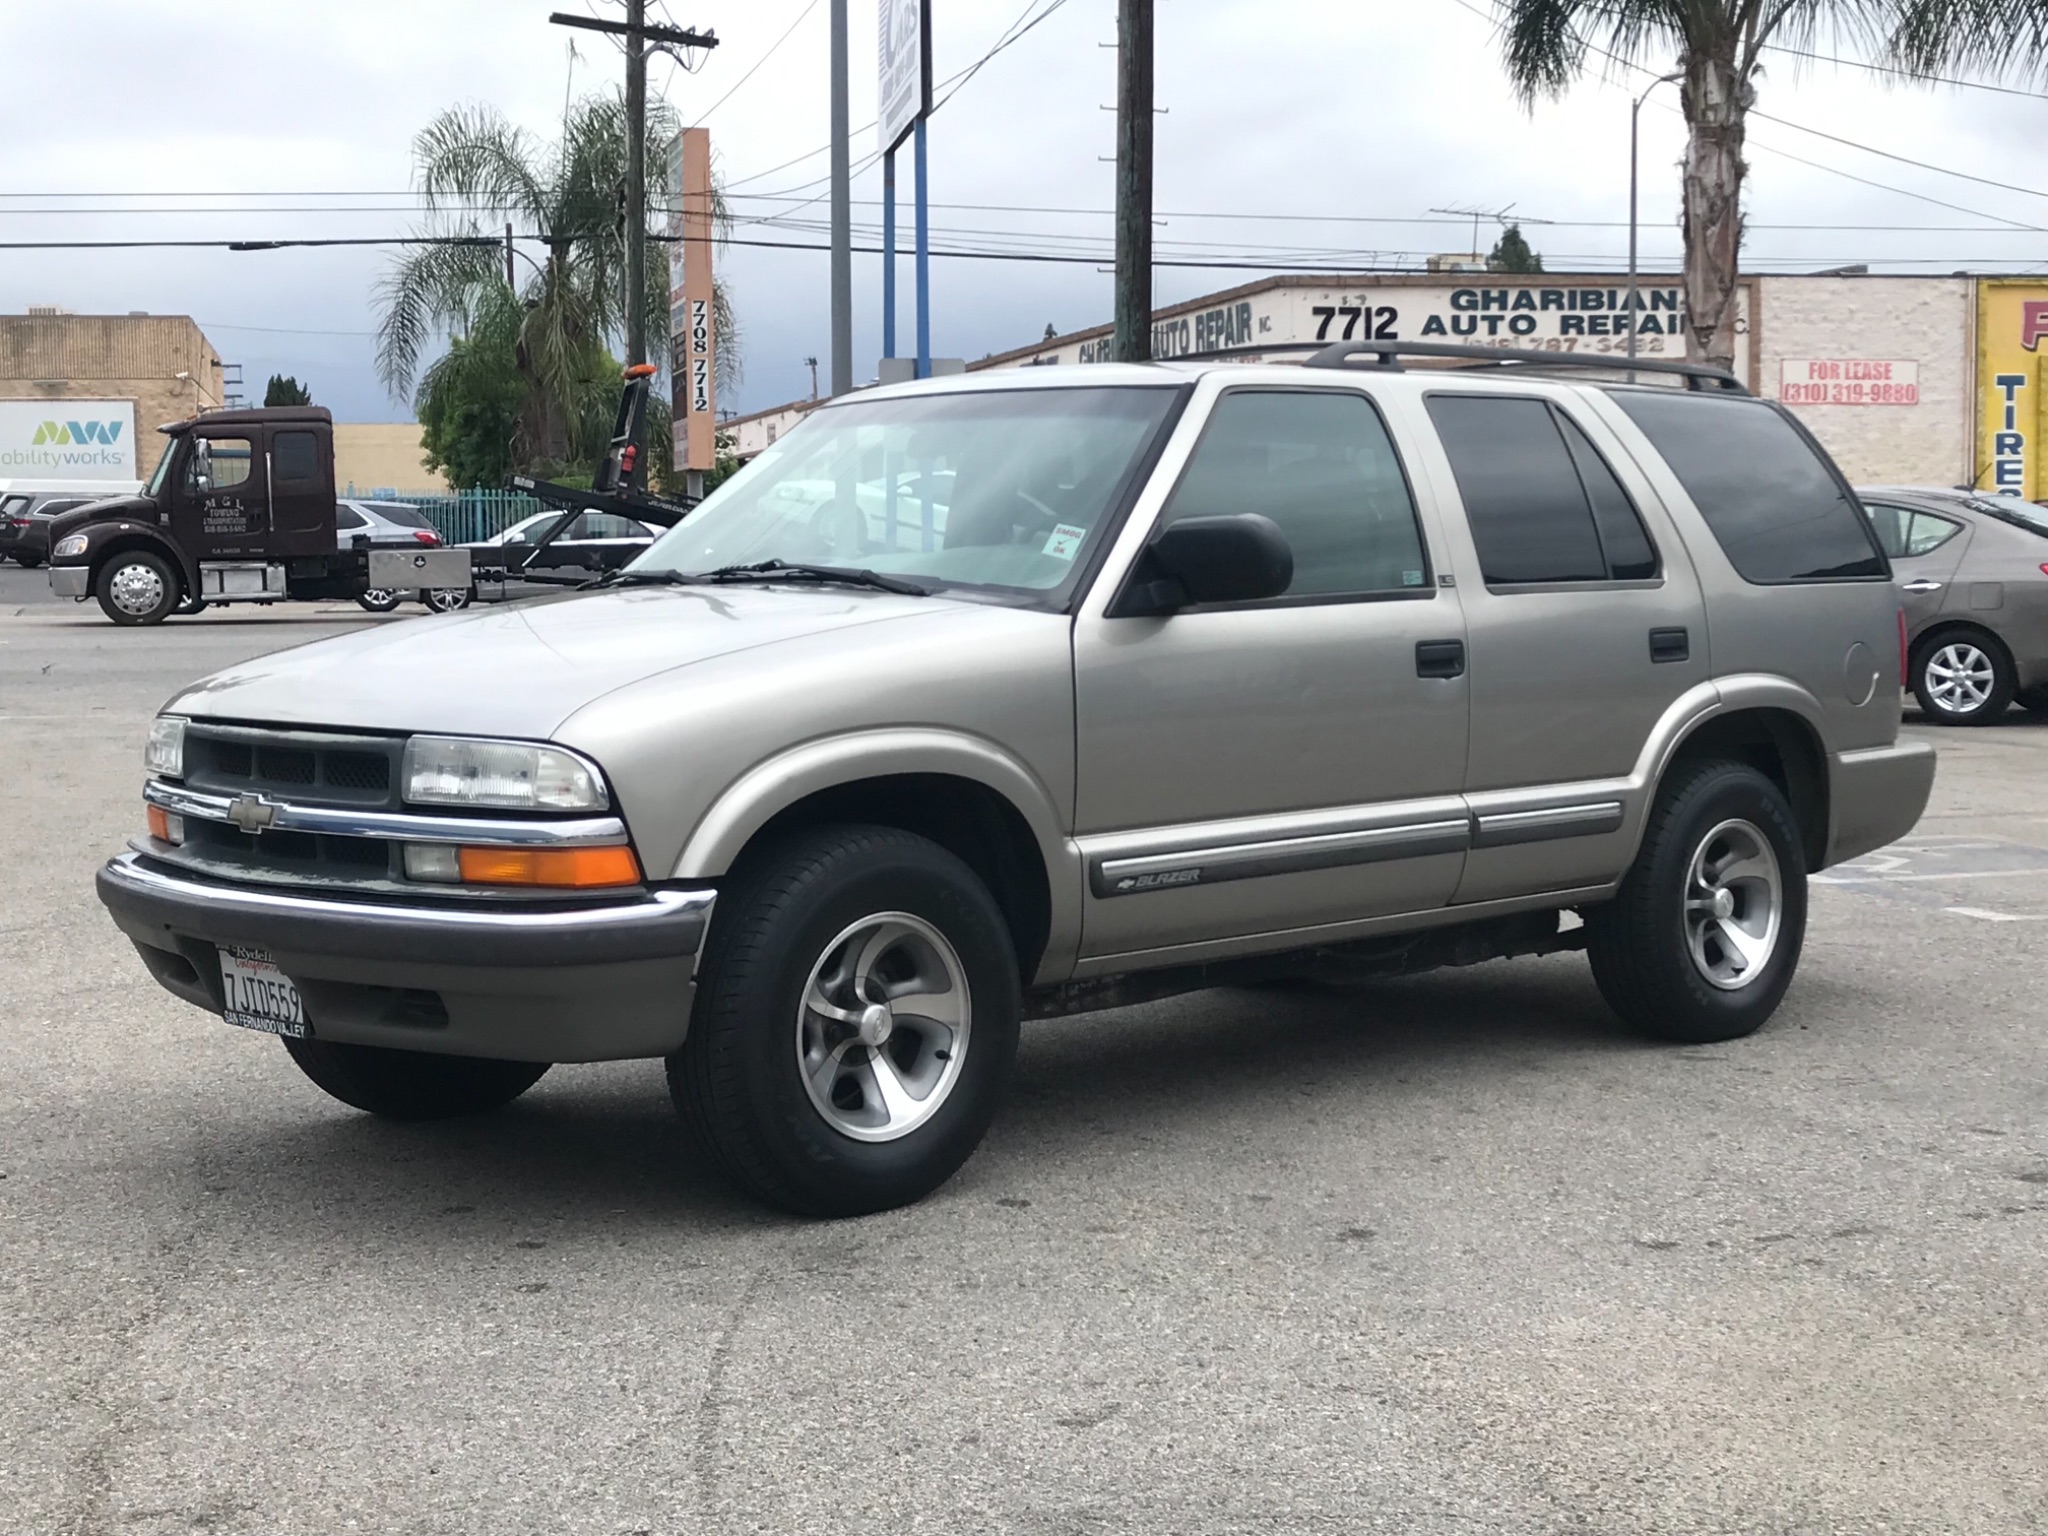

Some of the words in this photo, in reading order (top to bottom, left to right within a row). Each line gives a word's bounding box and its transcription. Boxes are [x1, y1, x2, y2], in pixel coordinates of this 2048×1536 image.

[1450, 289, 1678, 312] GHARIBIAN
[692, 300, 707, 354] 7708
[1195, 301, 1253, 353] REPAIR
[1312, 306, 1399, 341] 7712
[1421, 315, 1537, 336] AUTO
[1808, 362, 1840, 381] FOR
[1845, 362, 1893, 381] LEASE
[693, 359, 708, 412] 7712
[1784, 383, 1829, 402] (310)
[1996, 374, 2026, 497] TIRE
[0, 448, 123, 469] obilityworks
[209, 508, 240, 518] TOWING
[1055, 527, 1082, 539] SMOG
[1053, 545, 1066, 555] OK
[1135, 869, 1201, 888] BLAZER
[224, 972, 300, 1022] 7JID559
[223, 1010, 240, 1025] SAN
[239, 1014, 277, 1033] FERNANDO
[276, 1021, 305, 1038] VALLEY
